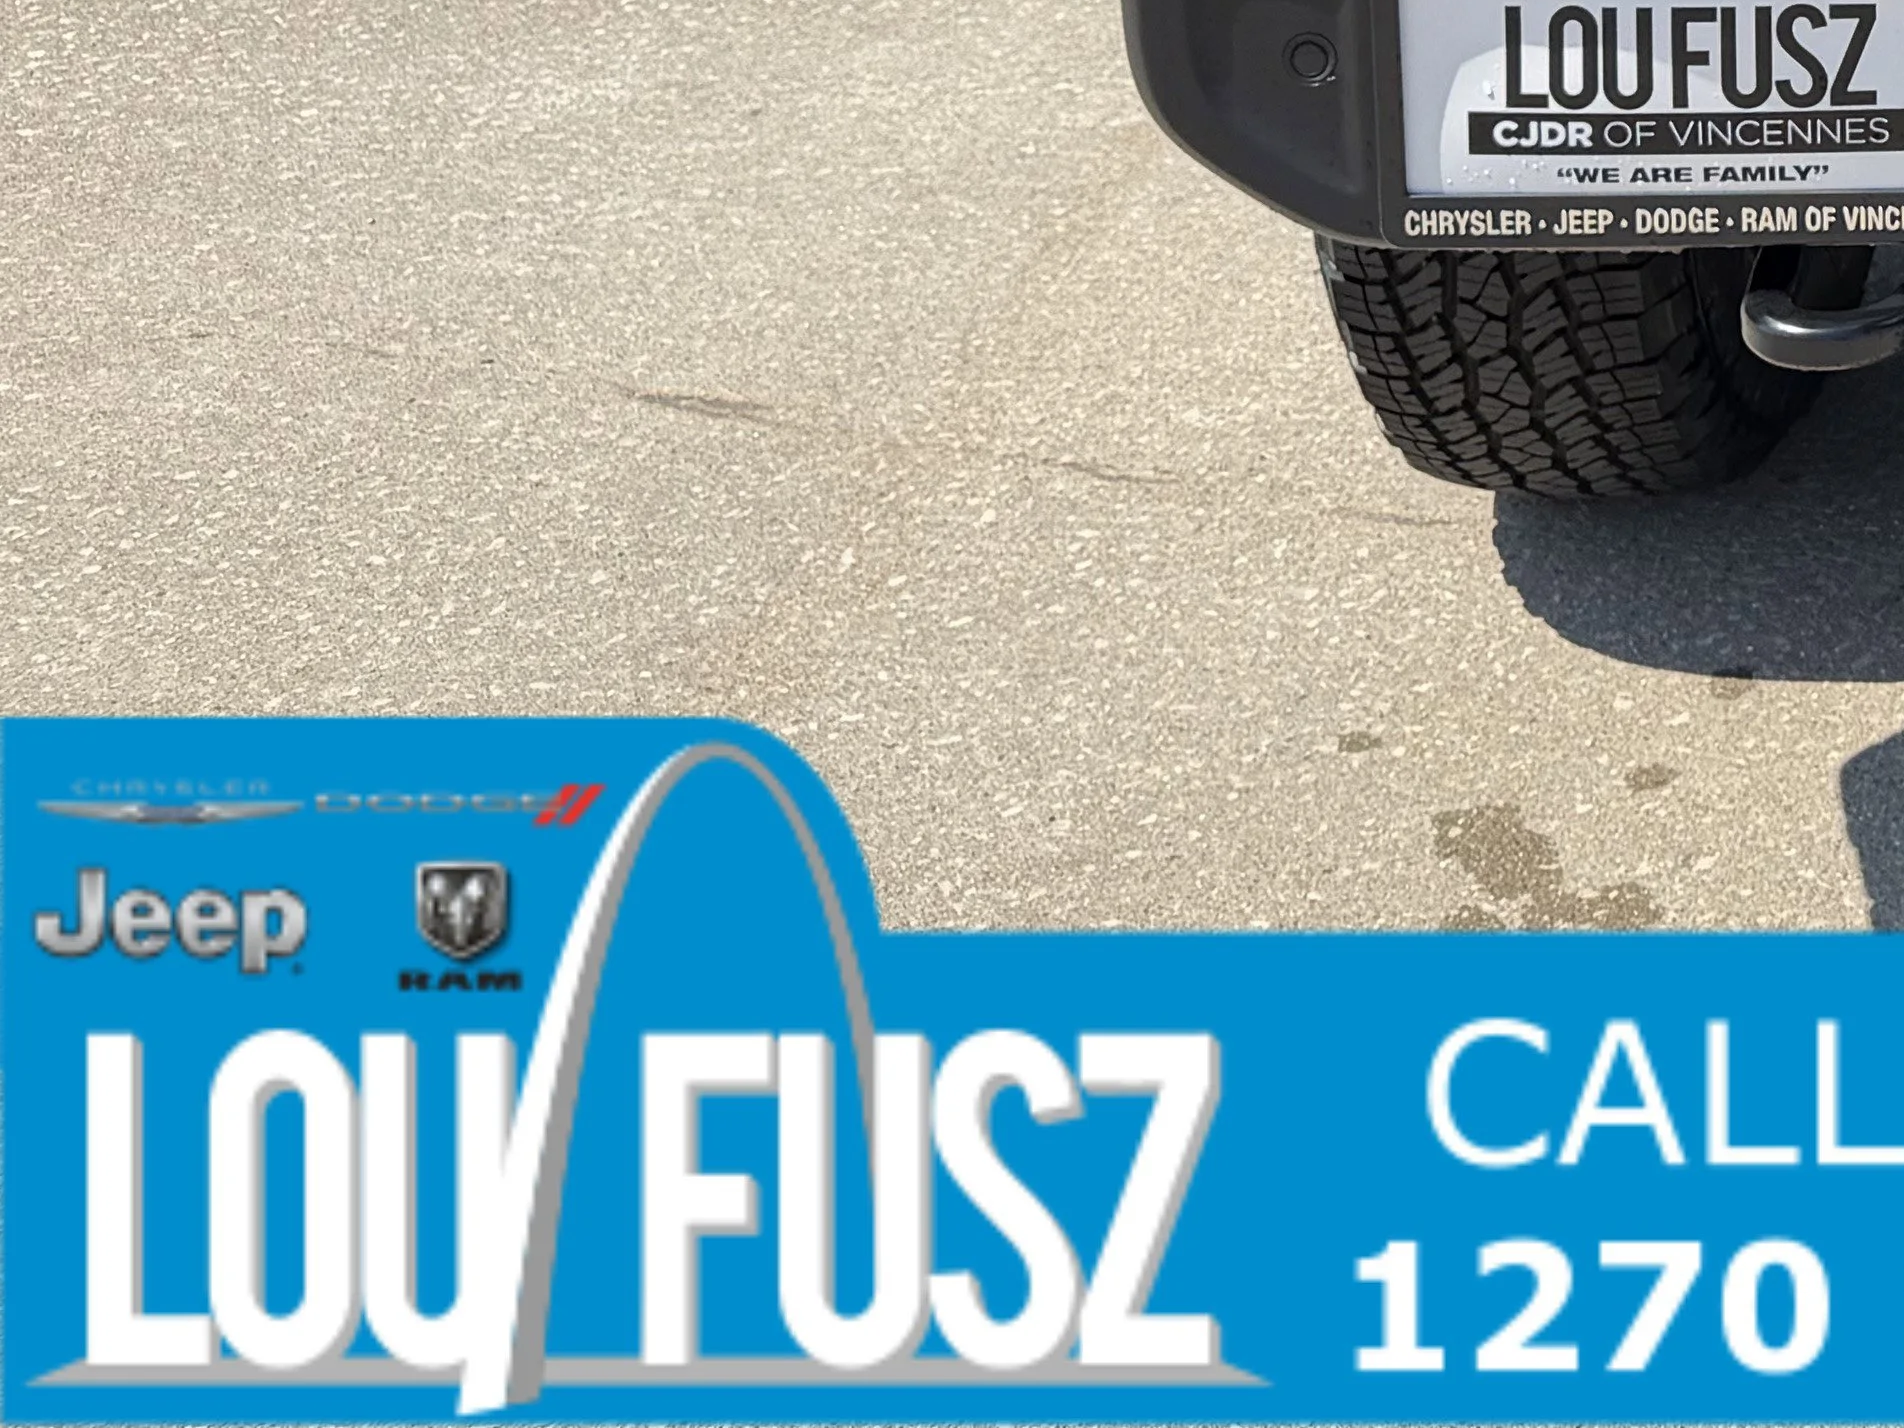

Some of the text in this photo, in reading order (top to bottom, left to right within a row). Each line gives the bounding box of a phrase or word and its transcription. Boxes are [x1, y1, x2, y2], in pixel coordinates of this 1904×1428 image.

[1504, 3, 1878, 110] LOU FUSZ
[1492, 117, 1890, 148] CJDR OF VINCENNES
[1629, 167, 1693, 183] ARE
[1404, 209, 1532, 237] CHRYSLER
[1552, 208, 1614, 235] JEEP
[1635, 206, 1720, 234] DODGE
[1741, 206, 1798, 233] RAM
[1804, 205, 1837, 232] OF
